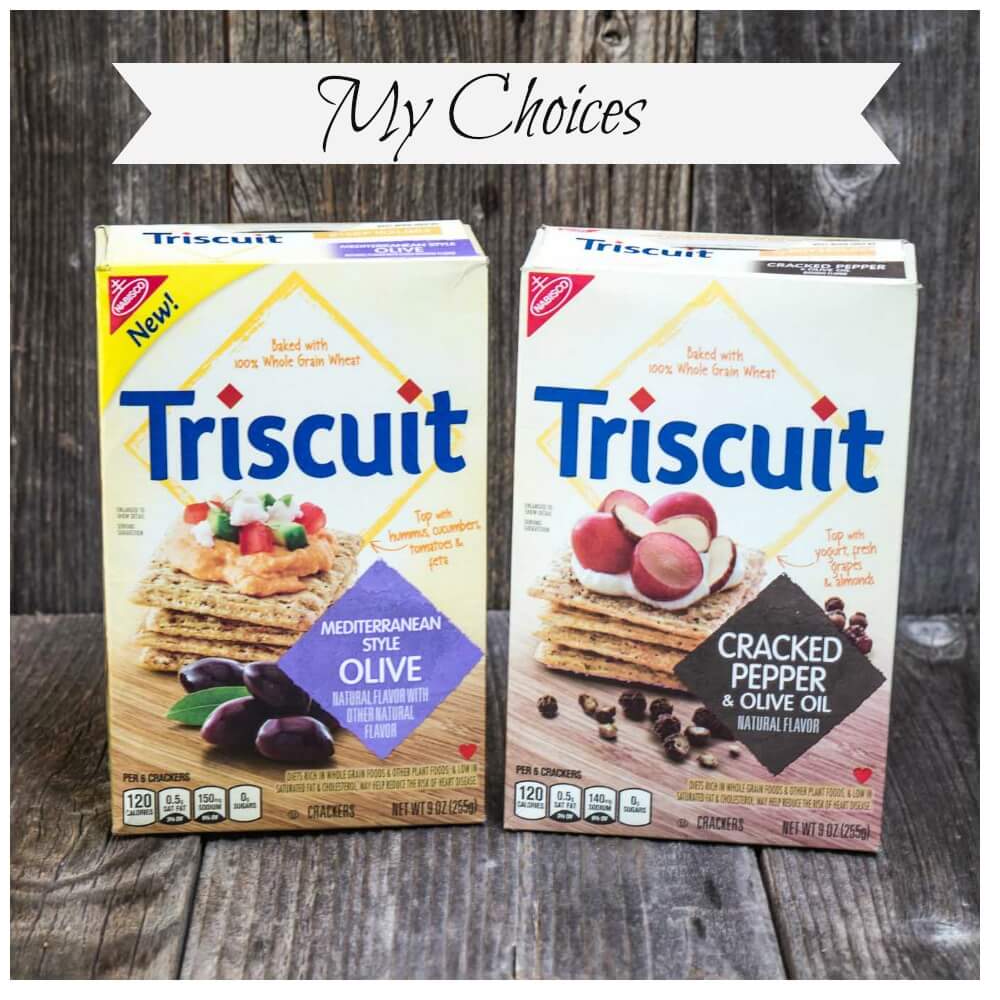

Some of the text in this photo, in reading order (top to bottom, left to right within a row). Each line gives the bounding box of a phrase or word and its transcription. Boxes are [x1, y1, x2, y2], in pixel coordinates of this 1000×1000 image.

[143, 231, 282, 245] Triscuit
[374, 245, 424, 254] OLIVE
[576, 238, 714, 259] Triscuit
[767, 262, 886, 271] CRACKED PEPPER
[533, 280, 569, 314] NABISCO
[126, 293, 179, 347] New!
[272, 337, 328, 352] Baked with
[234, 354, 360, 369] 100% Whole Grain Wheat
[687, 347, 744, 361] Baked with
[649, 363, 776, 379] 100% Whole Grain Wheat
[120, 383, 468, 481] Triscuit
[534, 386, 884, 493] Triscuit
[415, 508, 452, 524] Top with
[825, 529, 865, 542] Top with
[410, 541, 463, 557] tomatoes &
[428, 555, 449, 572] feta
[831, 560, 863, 576] grapes
[321, 616, 441, 635] MEDITERRANEAN
[362, 637, 400, 651] STYLE
[718, 632, 843, 663] CRACKED
[339, 656, 421, 684] OLIVE
[731, 666, 826, 692] PEPPER
[332, 687, 429, 706] NATURAL FLAVOR WITH
[722, 693, 831, 712] & OLIVE OIL
[346, 706, 414, 723] OTHER NATURAL
[365, 723, 397, 739] FLAVOR
[738, 715, 820, 733] NATURAL FLAVOR
[127, 793, 152, 808] 120
[519, 786, 543, 801] 120
[308, 804, 355, 819] CRACKERS
[697, 816, 744, 831] CRACKERS
